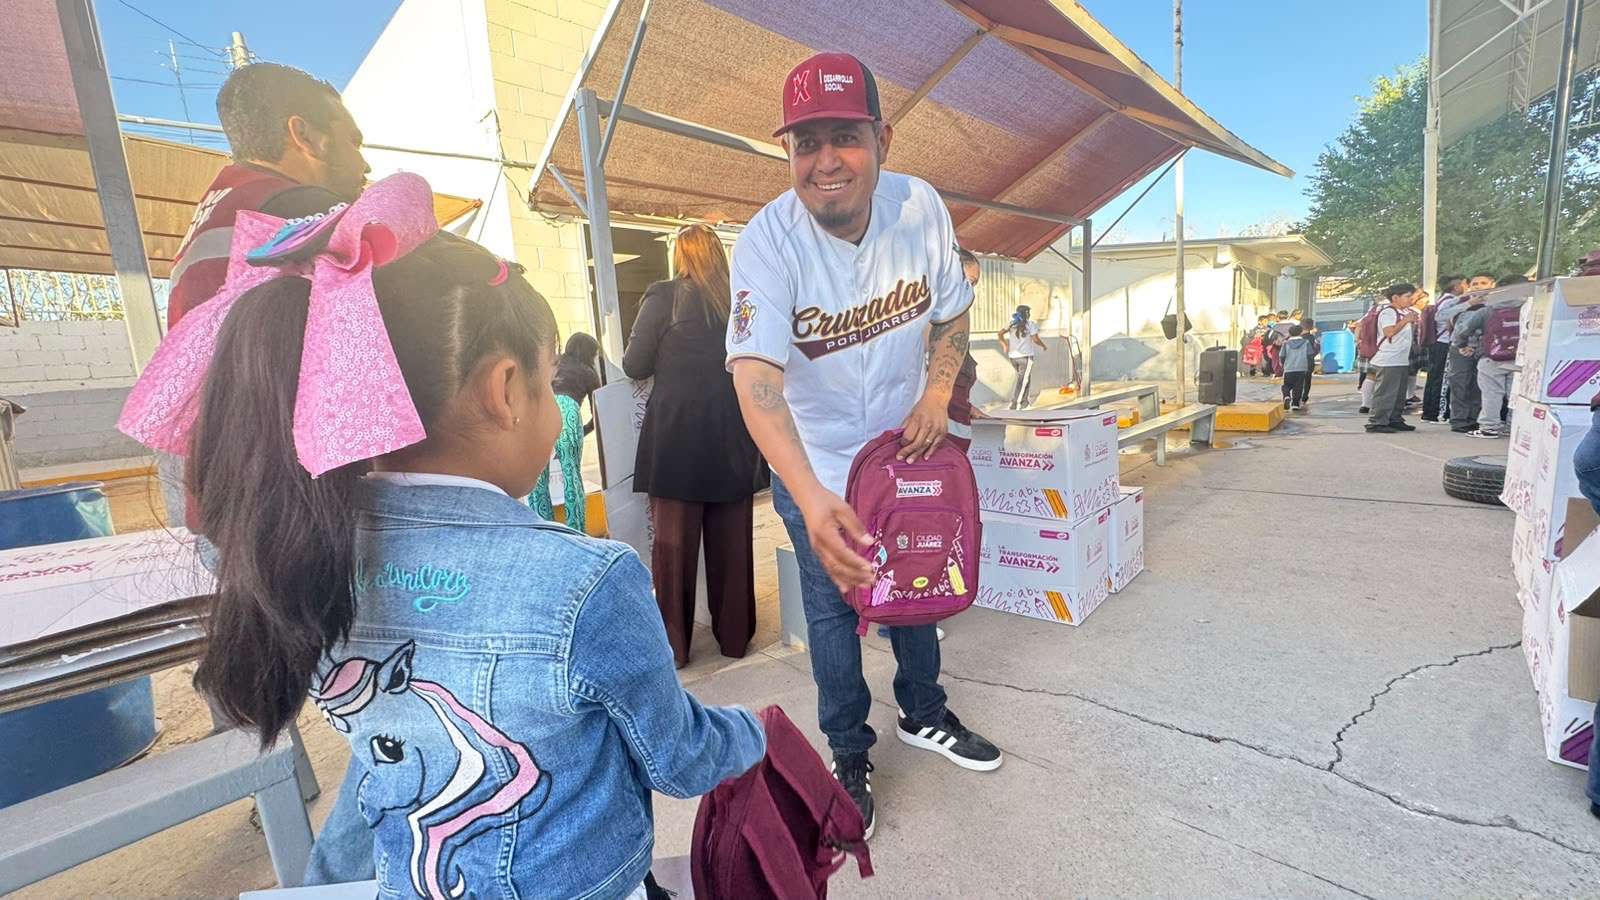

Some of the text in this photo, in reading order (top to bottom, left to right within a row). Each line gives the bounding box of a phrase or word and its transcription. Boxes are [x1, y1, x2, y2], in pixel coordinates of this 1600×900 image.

[823, 74, 854, 84] DESARROLLO
[824, 83, 845, 92] SOCIAL
[792, 274, 931, 339] Cruzadas
[826, 307, 919, 350] POR JUAREZ
[999, 451, 1054, 460] TRANSFORMACIÓN
[999, 457, 1041, 469] AVANZA
[898, 486, 932, 494] AVANZA
[999, 549, 1058, 562] TRANSFORMACIÓN
[999, 556, 1045, 570] AVANZA
